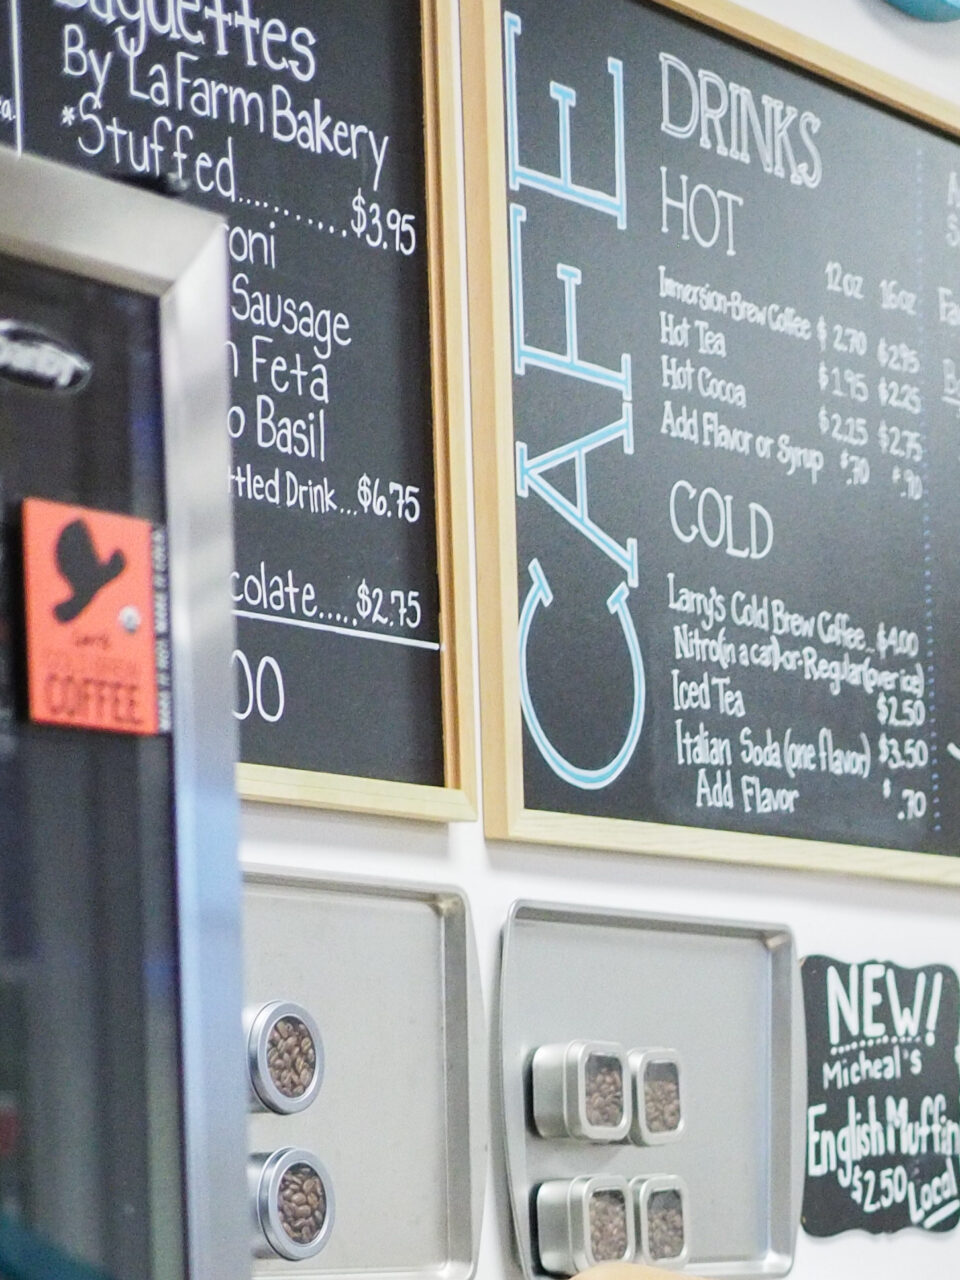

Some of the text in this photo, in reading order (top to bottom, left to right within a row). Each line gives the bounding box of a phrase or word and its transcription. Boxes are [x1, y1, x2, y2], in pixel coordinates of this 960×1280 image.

[62, 24, 113, 111] By
[271, 84, 389, 191] Bakery
[658, 52, 823, 189] DRINKS
[660, 166, 744, 256] HOT
[231, 273, 352, 360] Sausage
[659, 311, 691, 348] Hot
[694, 320, 728, 358] Tea
[251, 335, 329, 404] Feta
[503, 10, 646, 796] CAFE
[660, 355, 696, 390] Hot
[696, 366, 747, 409] Cocoa
[256, 394, 326, 462] Basil
[659, 401, 698, 444] Add
[701, 410, 752, 457] Flavor
[755, 435, 775, 458] or
[776, 433, 825, 486] Syrup
[669, 479, 775, 560] COLD
[667, 572, 726, 631] Larry's
[730, 591, 769, 632] Cold
[771, 599, 816, 639] Brew
[671, 668, 711, 711] Iced
[711, 676, 746, 718] Tea
[674, 718, 732, 766] Italian
[739, 726, 782, 770] Soda
[695, 766, 734, 810] Add
[740, 775, 801, 814] Flavor
[826, 962, 944, 1048] NEW!
[823, 1044, 923, 1091] Micheal's
[807, 1093, 960, 1189] English Muffin
